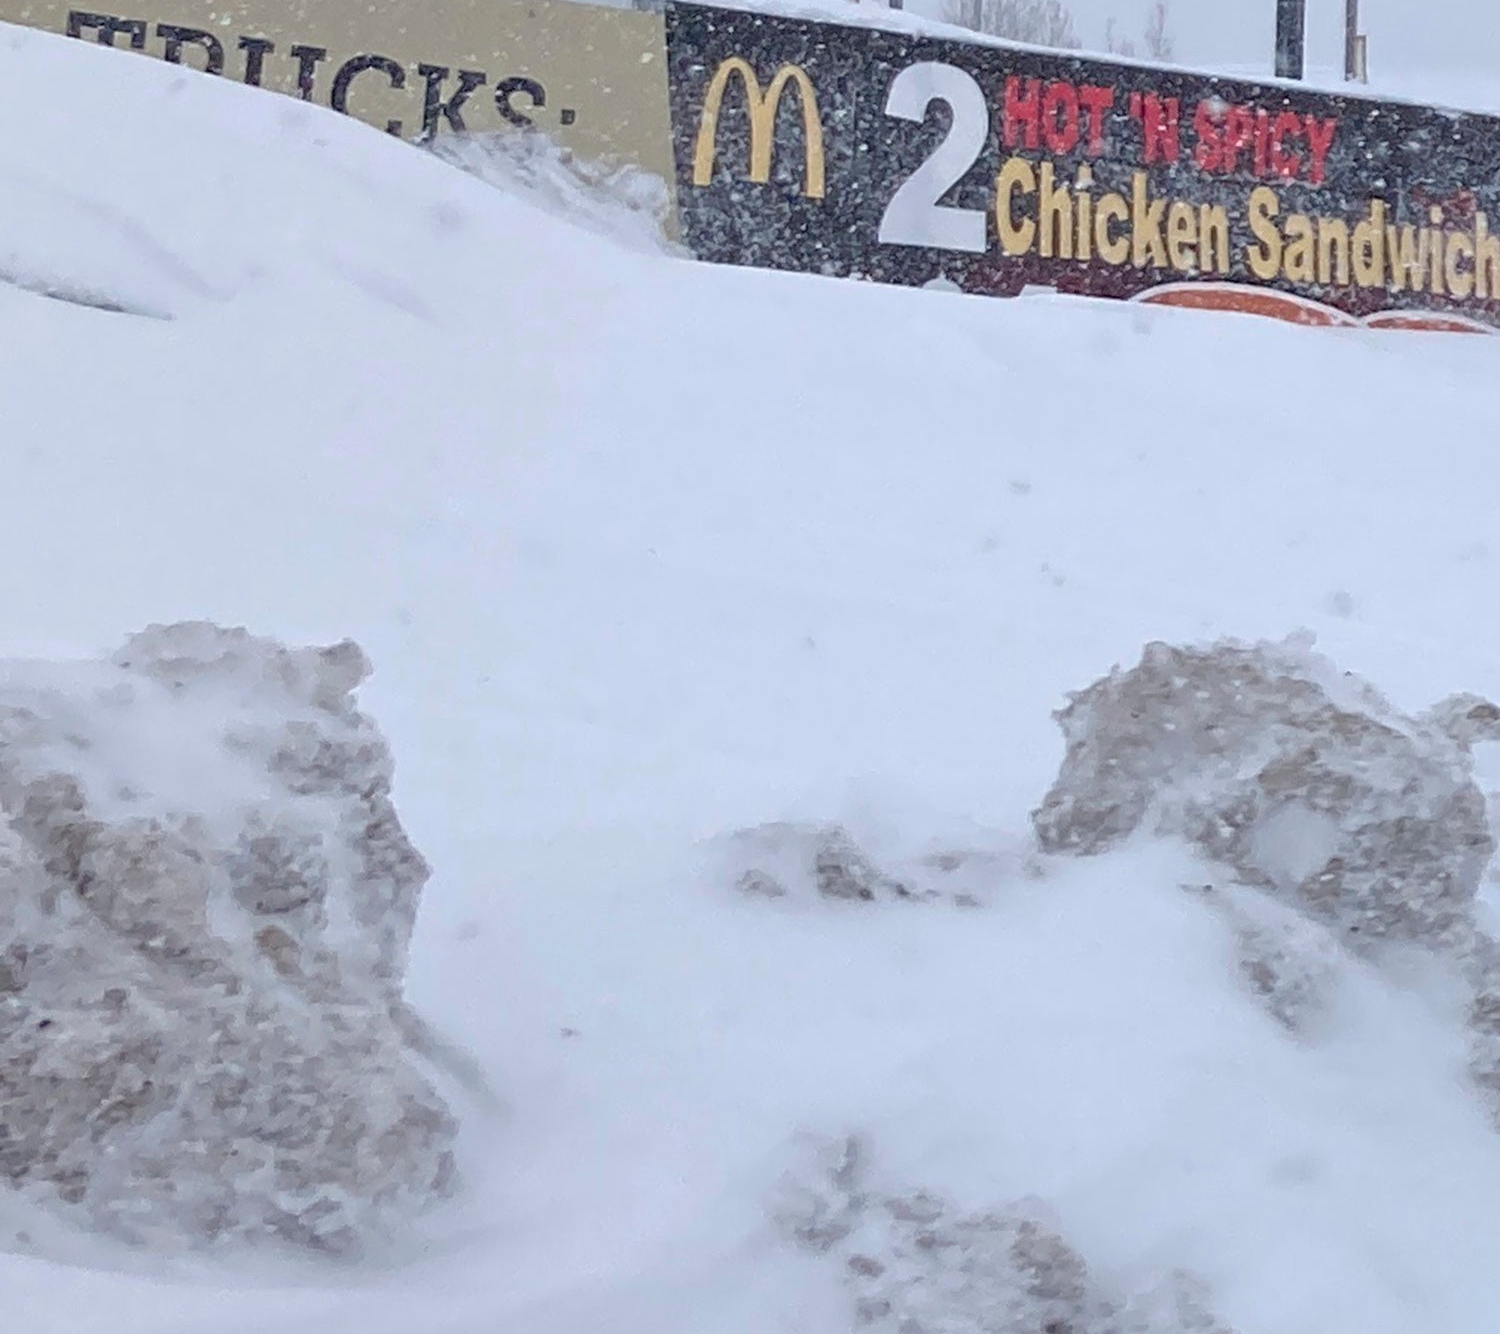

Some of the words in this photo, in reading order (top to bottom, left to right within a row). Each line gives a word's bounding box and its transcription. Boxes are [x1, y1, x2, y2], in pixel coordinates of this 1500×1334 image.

[878, 61, 989, 253] 2
[1001, 75, 1115, 156] HOT
[1193, 98, 1336, 185] SPICY
[996, 155, 1230, 274] Chicken
